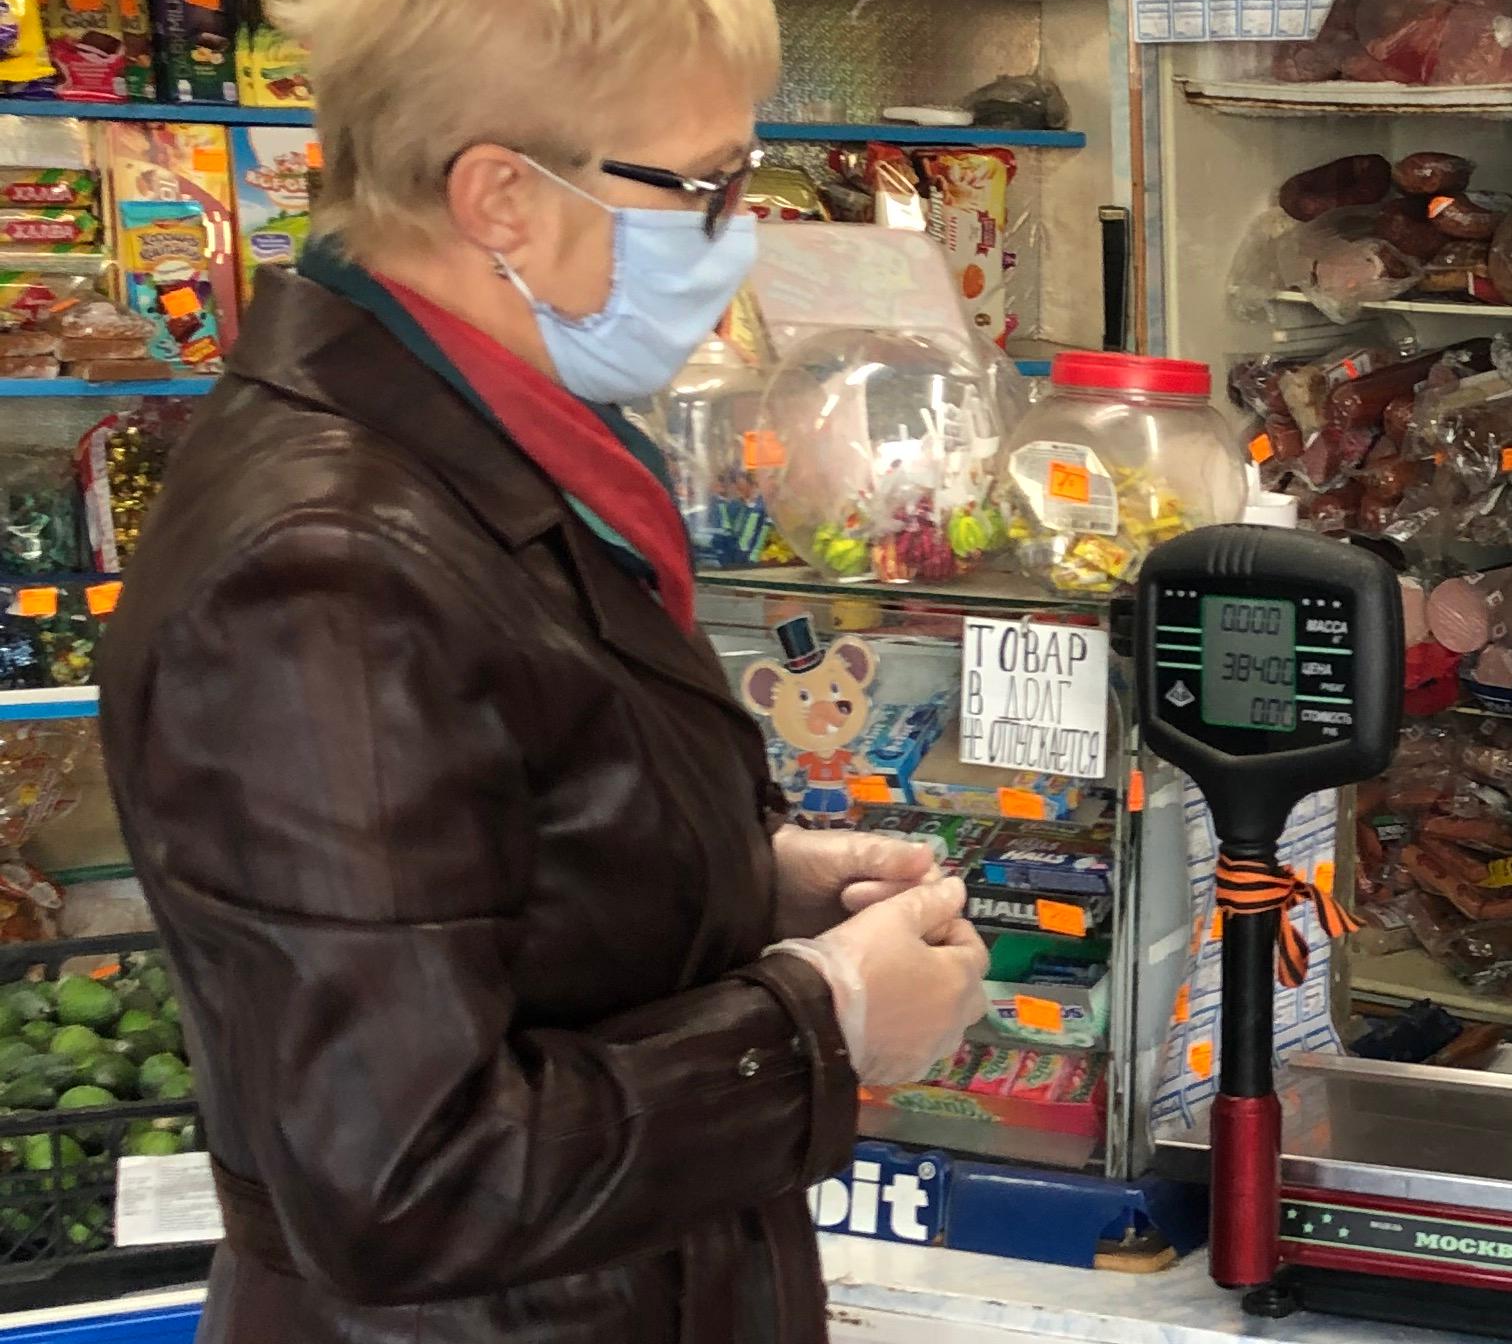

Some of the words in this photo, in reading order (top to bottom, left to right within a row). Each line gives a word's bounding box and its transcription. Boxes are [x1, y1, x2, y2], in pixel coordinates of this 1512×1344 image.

[968, 624, 1088, 676] ТОВАР
[967, 670, 984, 715] В
[998, 675, 1072, 724] ДОЛГ
[968, 897, 1038, 920] HALL
